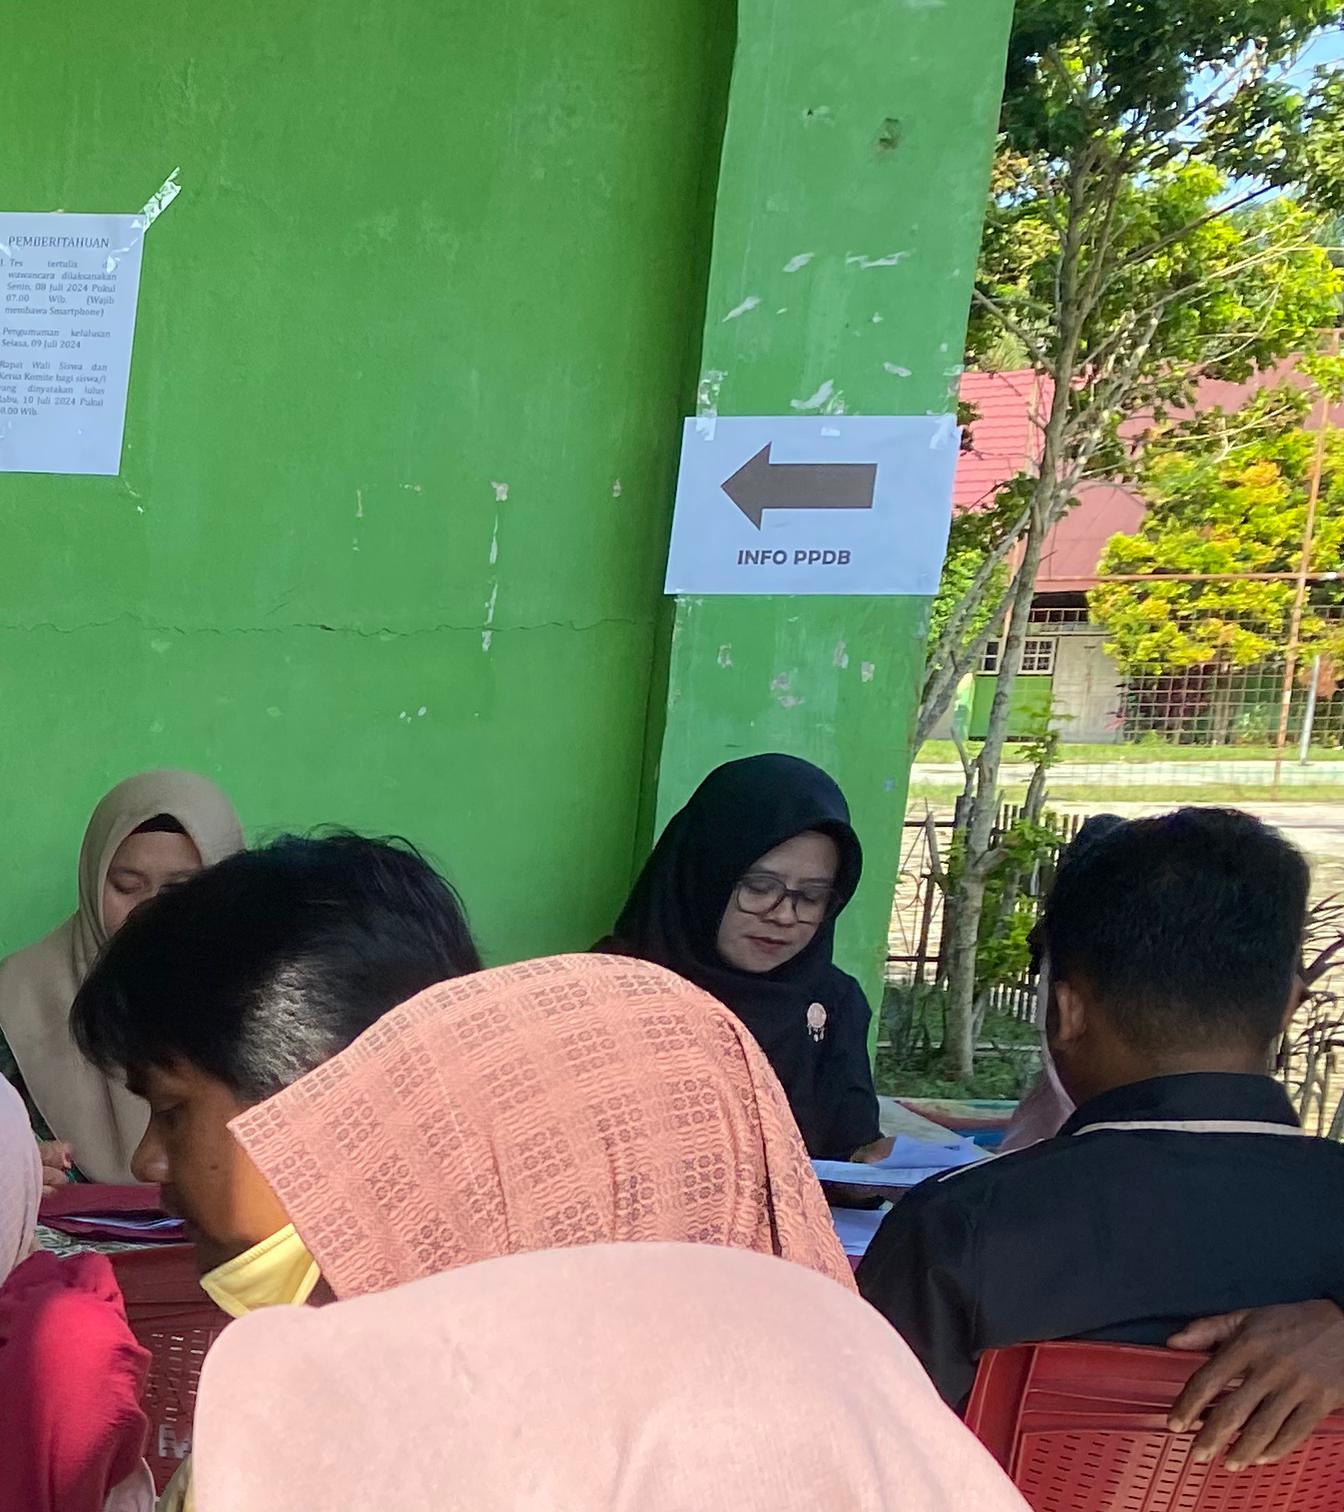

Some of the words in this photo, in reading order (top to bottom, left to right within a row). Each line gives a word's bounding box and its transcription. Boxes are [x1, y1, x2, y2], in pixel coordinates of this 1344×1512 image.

[8, 236, 110, 249] PEMBERITAHUAN
[10, 259, 23, 267] Tes
[66, 283, 88, 292] 2024
[91, 284, 116, 293] Pukul
[5, 307, 47, 315] membawa
[49, 307, 105, 317] Smartphone)
[2, 327, 60, 338] Pengumuman
[59, 340, 81, 349] 2024
[0, 360, 23, 370] Rapat
[23, 395, 34, 404] 10
[54, 397, 76, 406] 2024
[737, 549, 788, 566] INFO
[793, 549, 852, 566] PPDB
